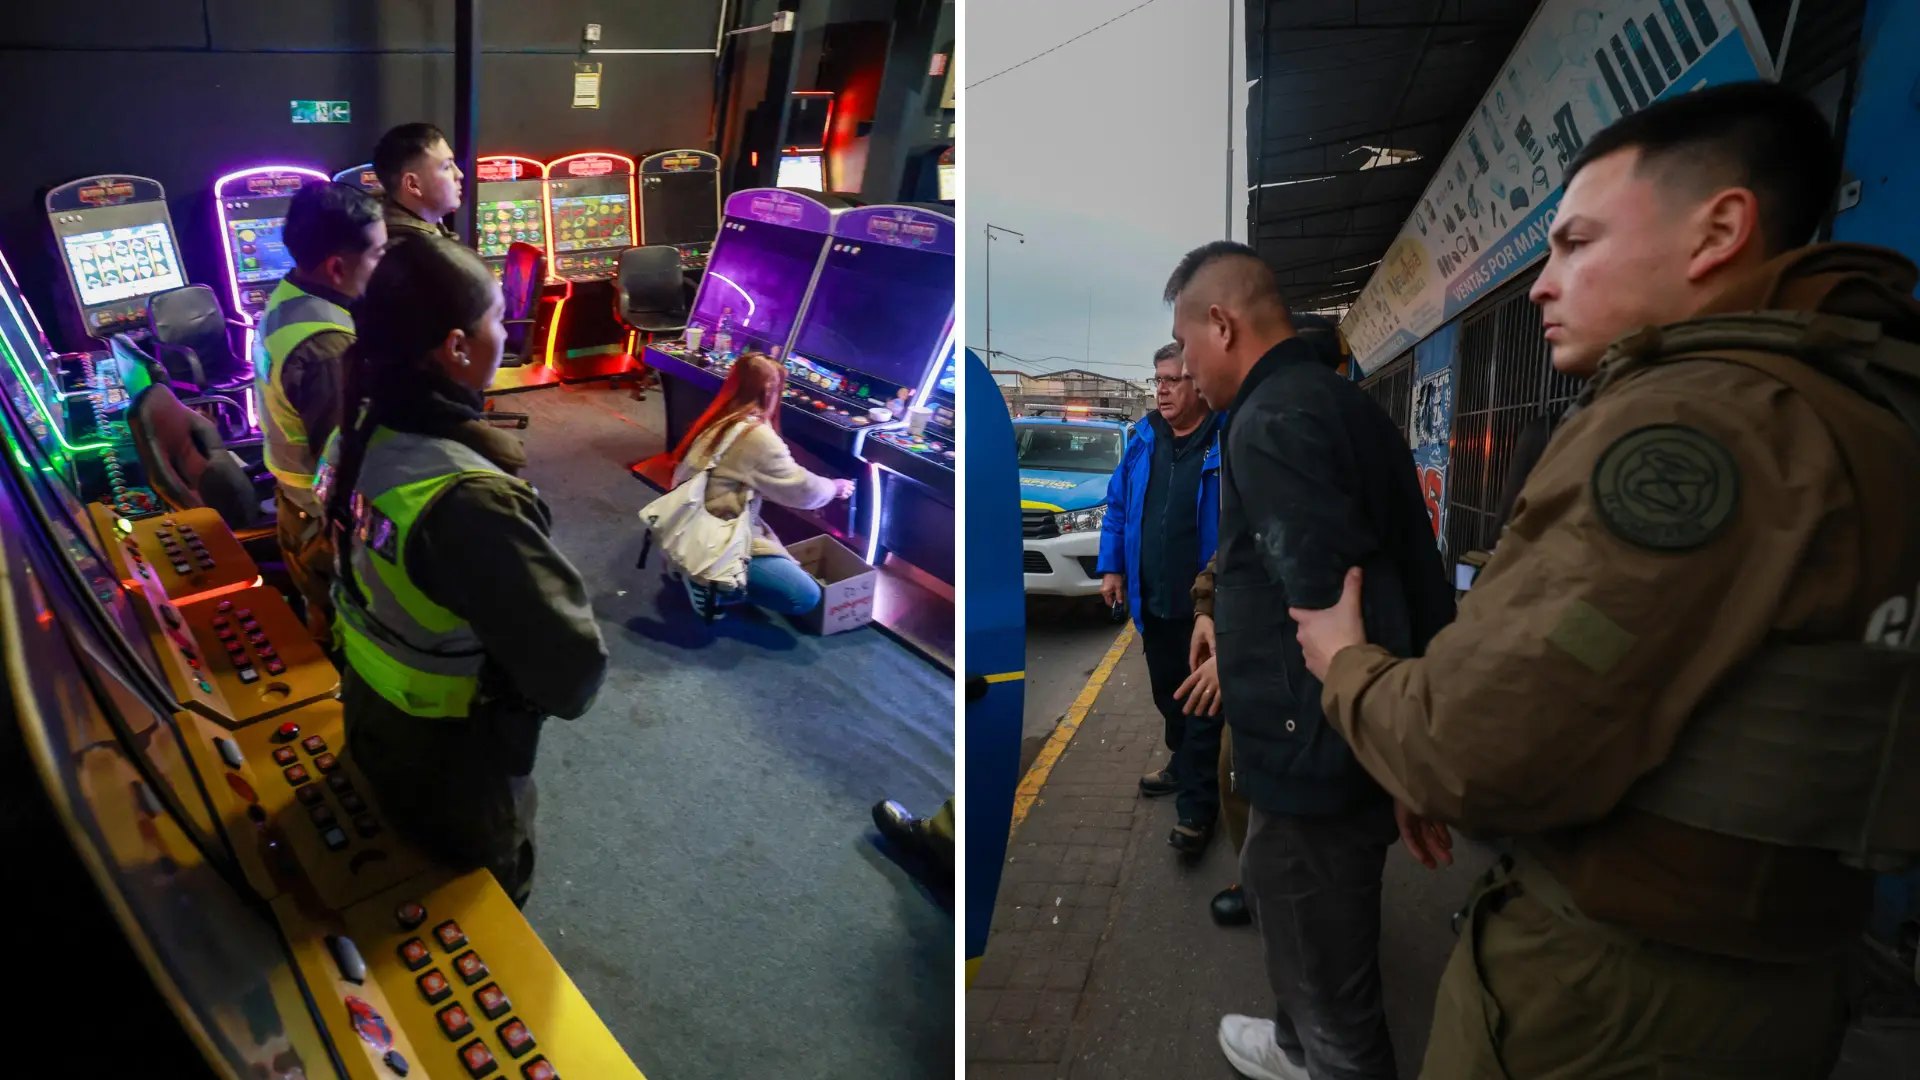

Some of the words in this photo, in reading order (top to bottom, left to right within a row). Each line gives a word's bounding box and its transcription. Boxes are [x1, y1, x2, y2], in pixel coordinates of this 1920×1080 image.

[1453, 264, 1490, 301] VENTAS
[1488, 244, 1517, 275] POR
[1513, 200, 1560, 256] MAYO
